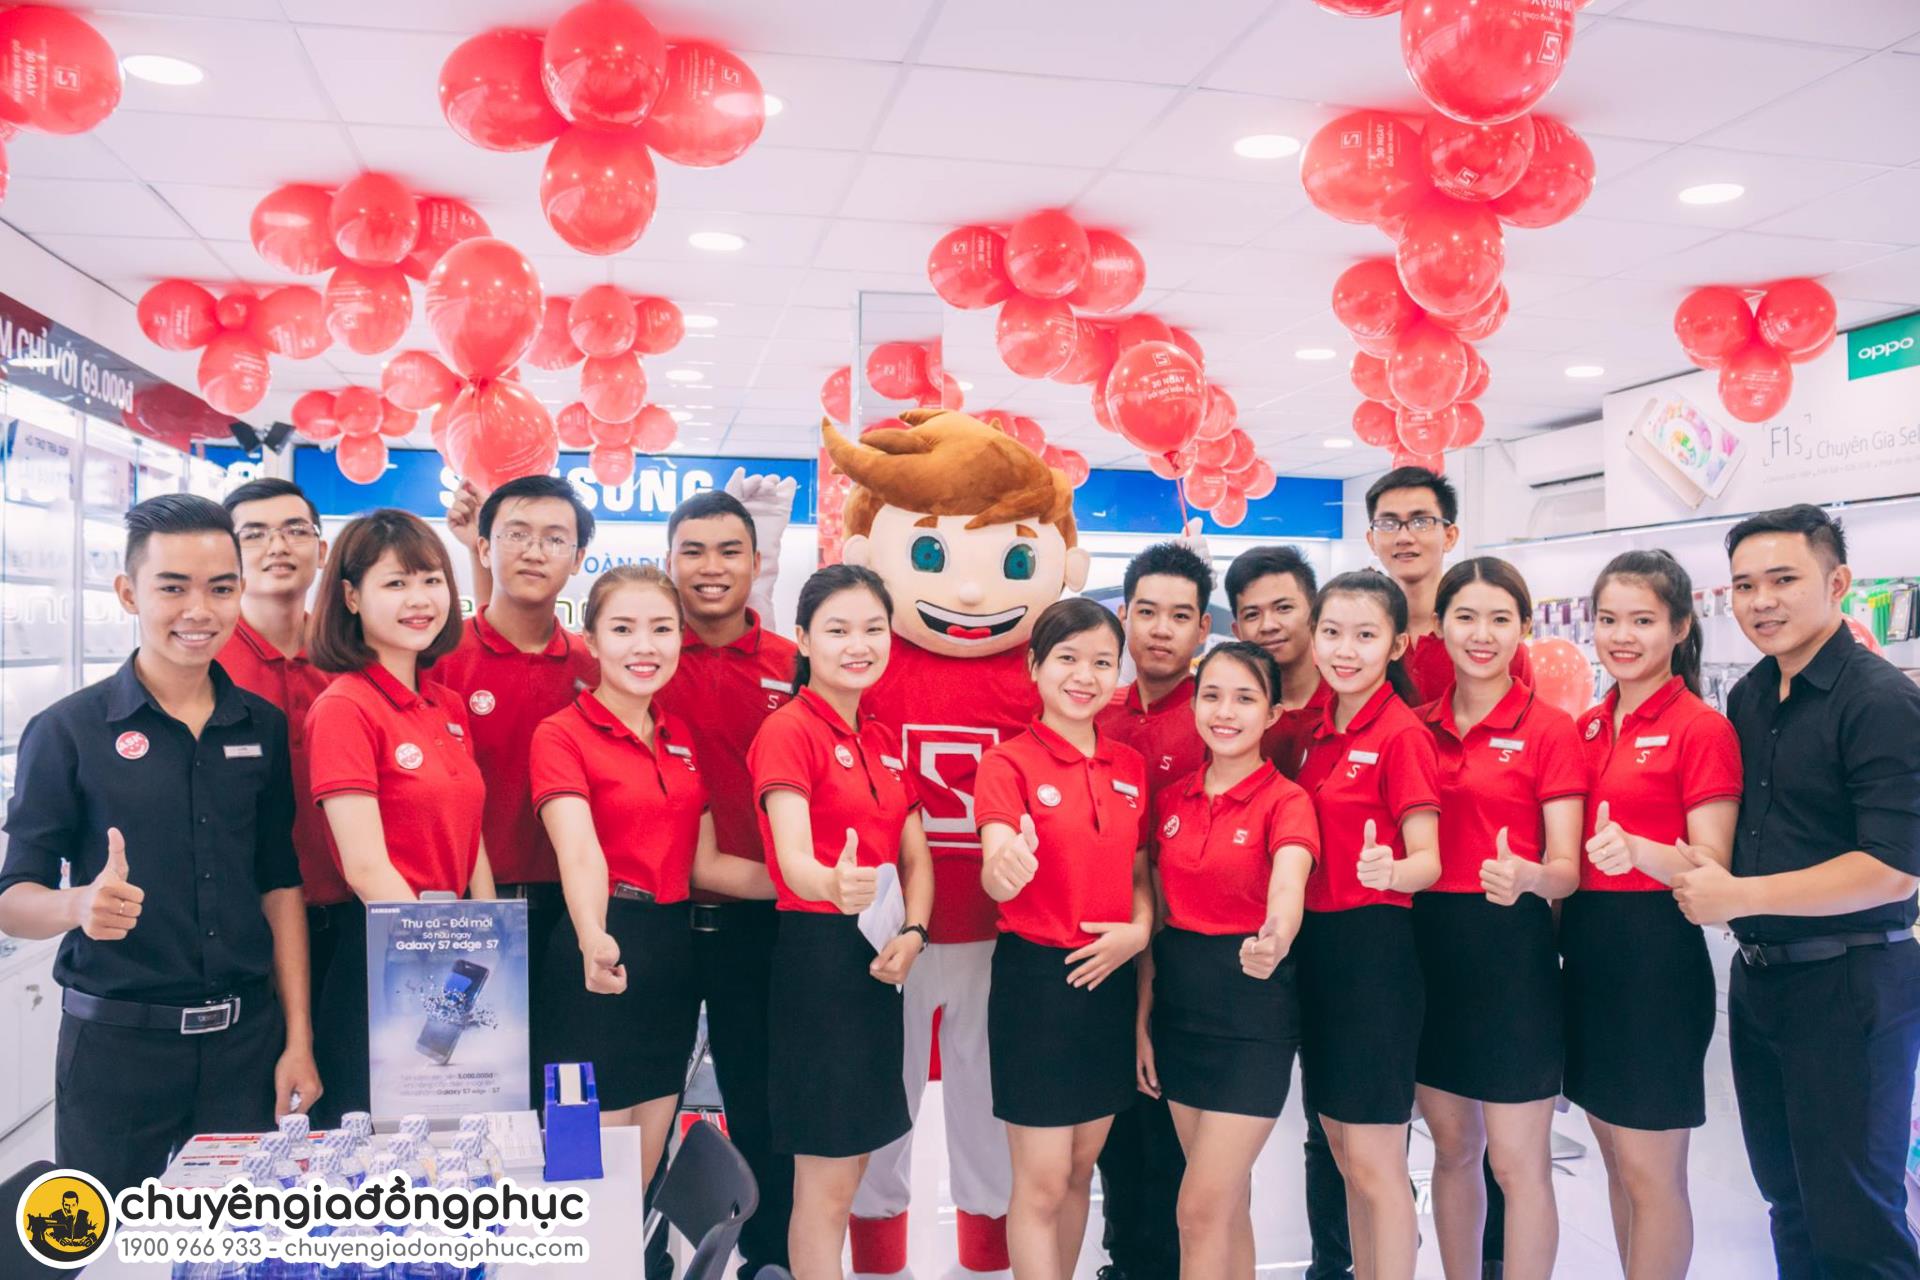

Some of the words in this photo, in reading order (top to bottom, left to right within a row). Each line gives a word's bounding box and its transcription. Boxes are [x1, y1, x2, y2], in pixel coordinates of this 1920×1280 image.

[1872, 430, 1895, 450] Gia
[401, 918, 423, 929] Thu
[425, 918, 440, 929] cũ
[450, 916, 469, 929] Đổi
[471, 917, 494, 929] mới
[451, 932, 473, 941] ngay
[396, 941, 435, 953] Galaxy
[438, 941, 451, 950] S7
[452, 941, 482, 952] edge
[486, 940, 499, 949] S7
